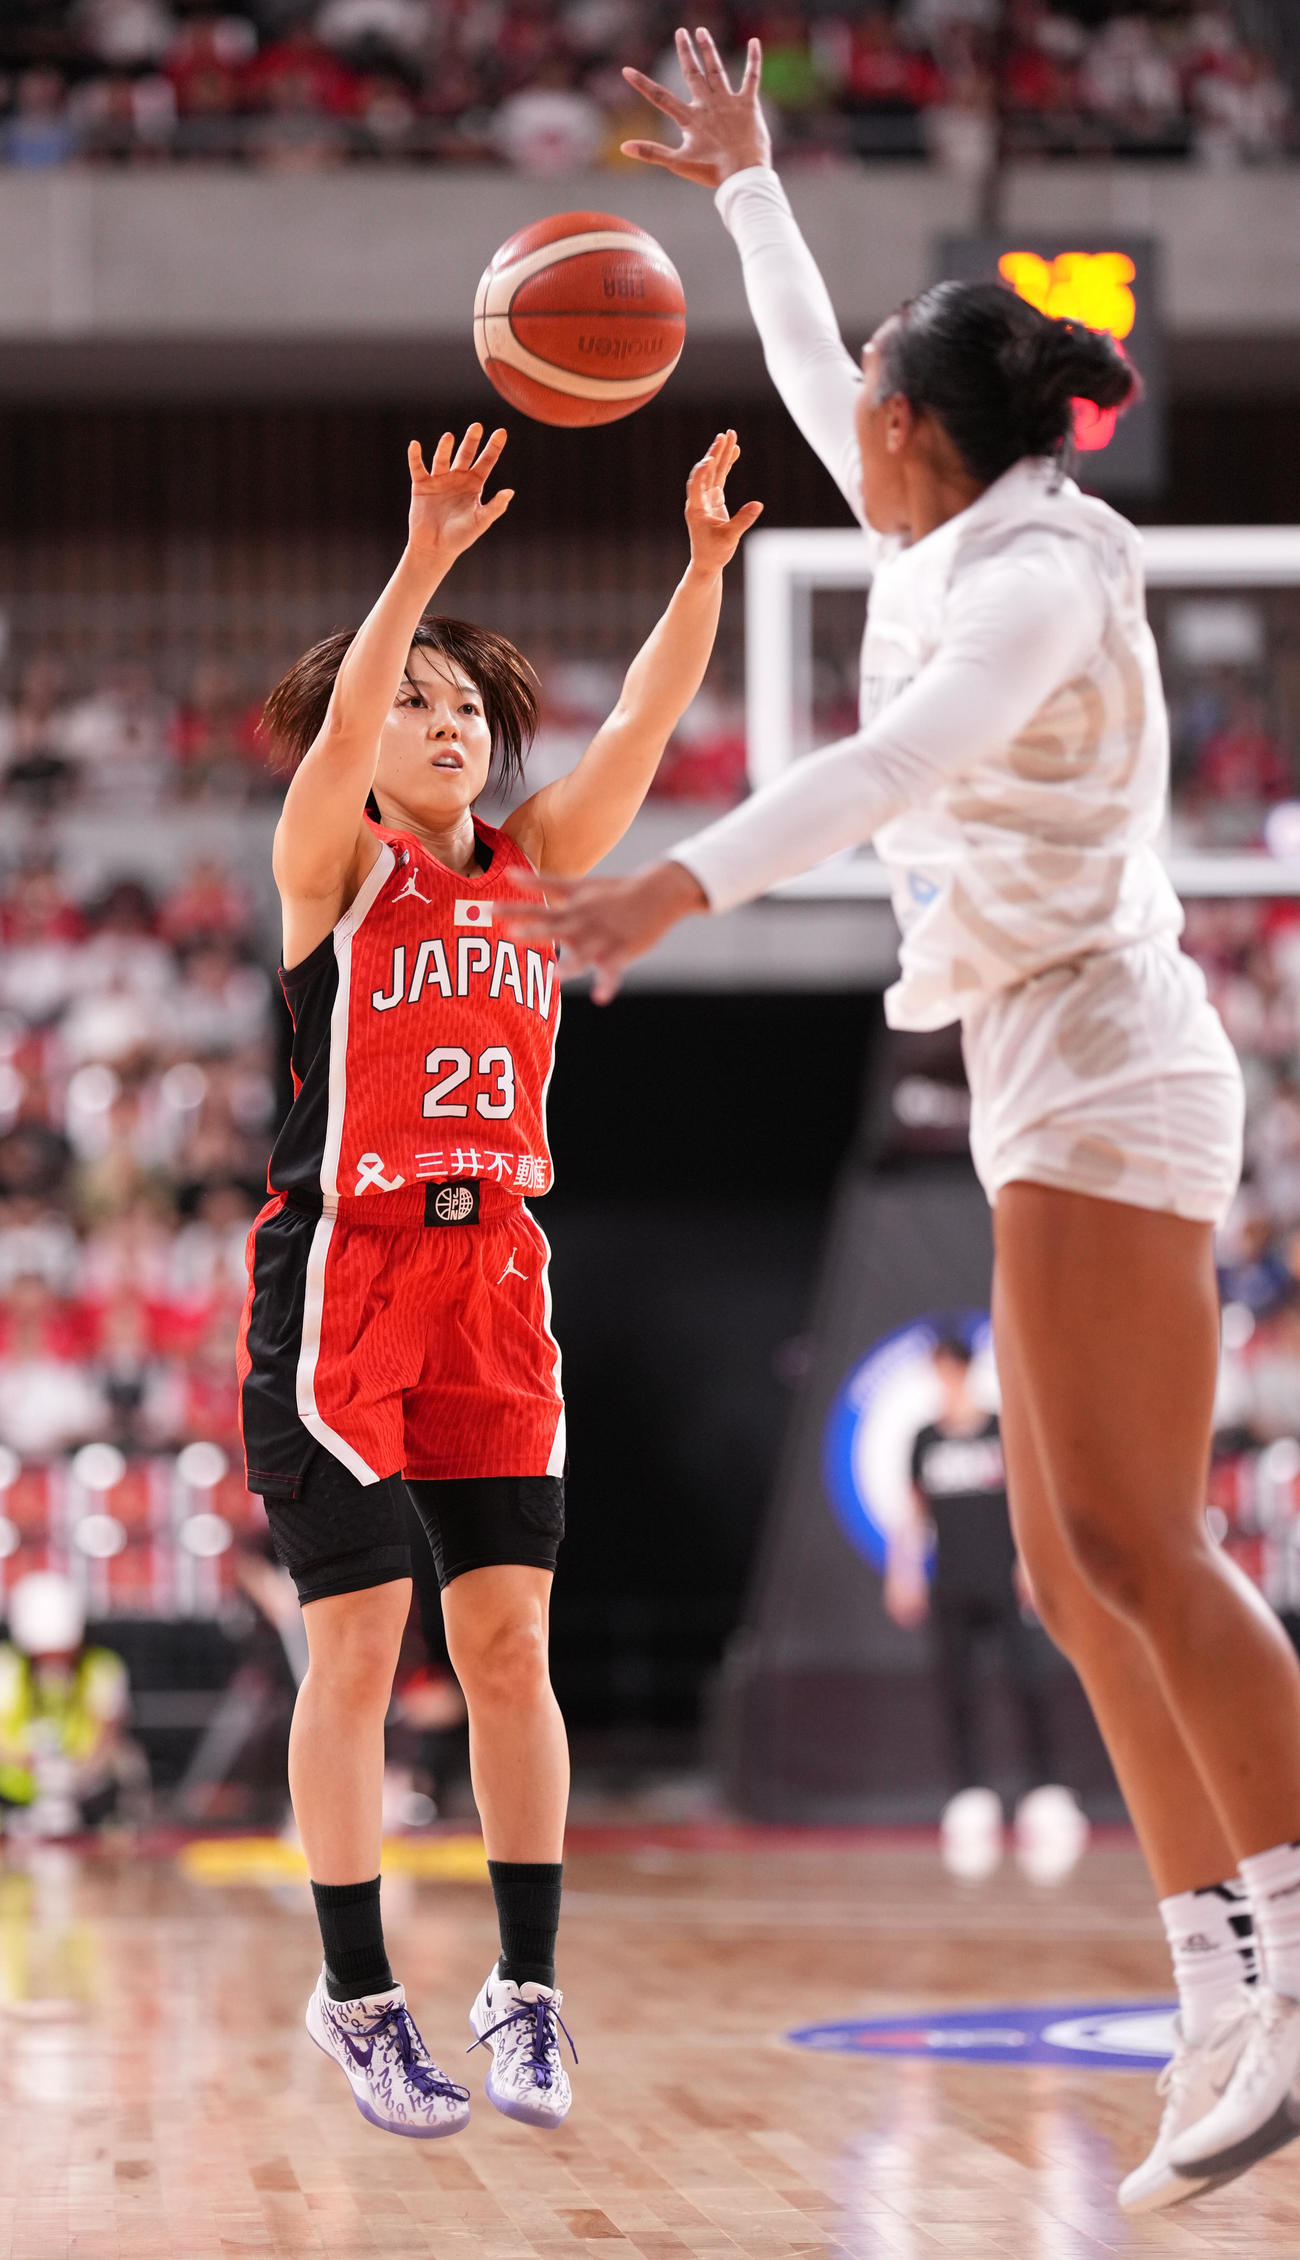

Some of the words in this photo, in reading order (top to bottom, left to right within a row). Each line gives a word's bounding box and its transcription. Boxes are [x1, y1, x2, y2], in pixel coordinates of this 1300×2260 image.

[603, 278, 645, 297] FIBA
[578, 336, 662, 359] molten
[371, 936, 556, 1022] JAPAN
[422, 1046, 516, 1120] 23
[414, 1147, 549, 1190] 三井不動産
